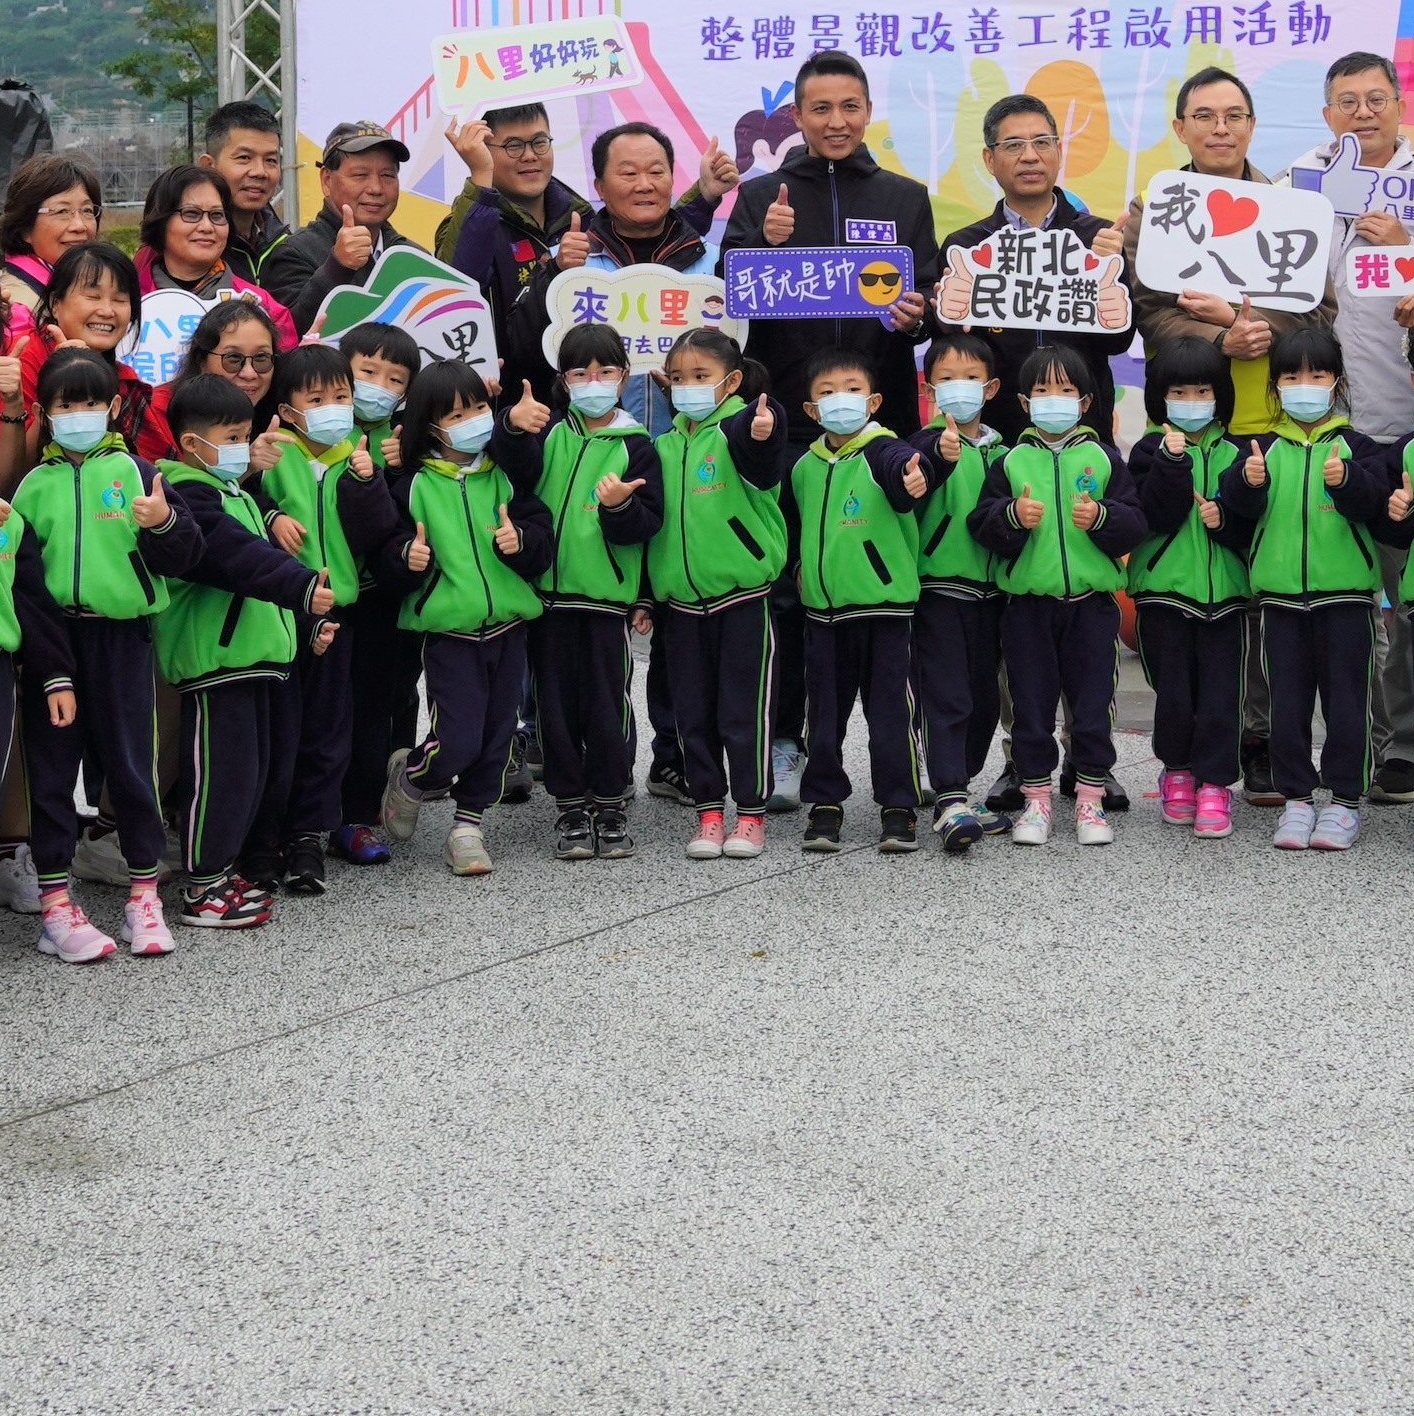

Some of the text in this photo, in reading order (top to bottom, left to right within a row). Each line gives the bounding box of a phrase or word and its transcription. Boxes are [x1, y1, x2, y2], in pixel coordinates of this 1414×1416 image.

[455, 37, 600, 89] 八里好好玩
[1149, 182, 1205, 245] 我
[997, 228, 1081, 276] 新北
[1178, 229, 1319, 303] 八里
[1355, 253, 1391, 289] 我
[571, 286, 690, 326] 來八里
[734, 257, 856, 310] 哥就是帥
[971, 273, 1100, 326] 民政讚
